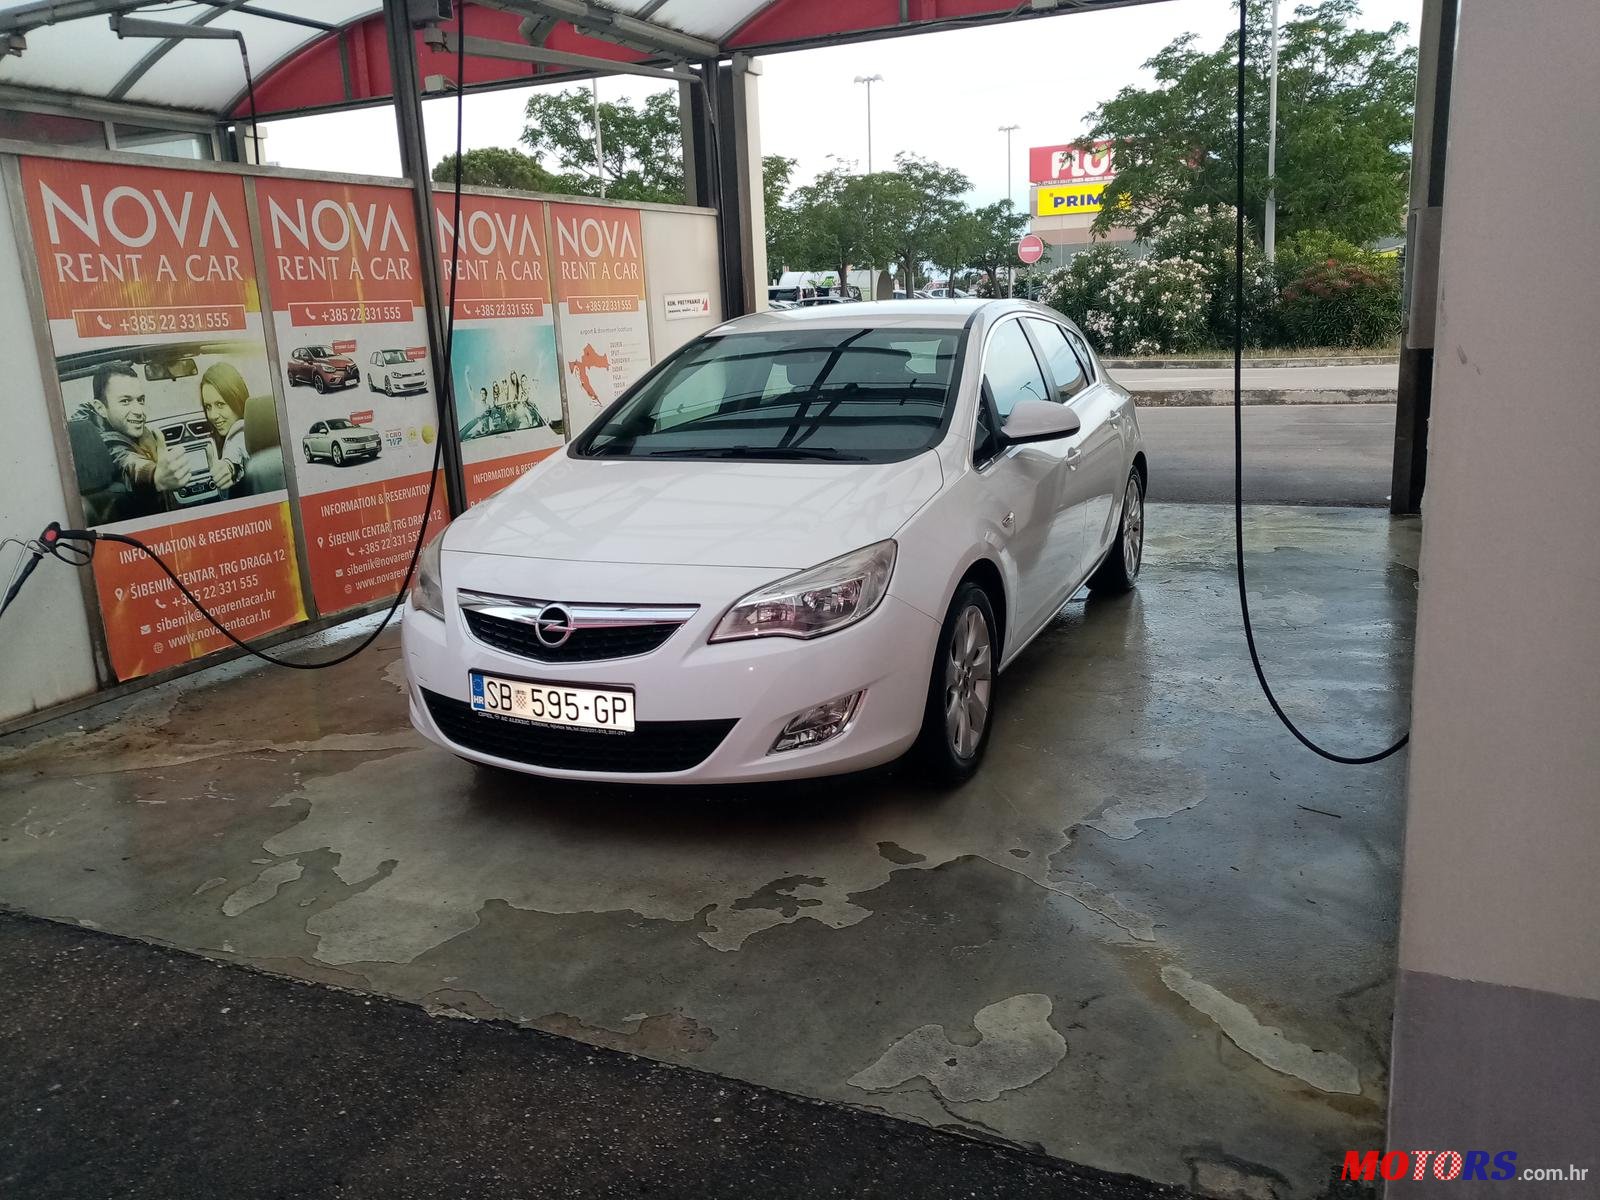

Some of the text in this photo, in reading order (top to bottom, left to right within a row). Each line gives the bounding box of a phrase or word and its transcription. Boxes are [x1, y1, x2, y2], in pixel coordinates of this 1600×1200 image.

[39, 179, 239, 249] NOVA
[1053, 194, 1102, 208] PRIM
[268, 196, 410, 252] NOVA
[436, 207, 541, 257] NOVA
[556, 216, 637, 258] NOVA
[54, 252, 244, 283] RENT A CAR
[277, 255, 413, 281] RENT A CAR
[444, 258, 544, 282] RENT A CAR
[562, 261, 639, 280] RENT A CAR
[321, 306, 401, 322] +385 22 331 555
[475, 303, 535, 317] +385 22 331 555
[585, 301, 600, 312] +385
[600, 301, 609, 311] 22
[621, 300, 632, 310] 555
[119, 312, 230, 332] +385 22 331 555
[473, 467, 515, 485] INFORMATION
[321, 483, 431, 518] INFORMATION & RESERVATION
[199, 533, 208, 546] &
[209, 518, 273, 545] RESERVATION
[328, 527, 361, 548] ŠIBENIK
[361, 522, 392, 540] CENTAR,
[392, 518, 407, 531] TRG
[433, 509, 442, 523] 12
[358, 539, 380, 556] +385
[381, 537, 391, 551] 22
[392, 533, 406, 549] 331
[130, 576, 175, 600] ŠIBENIK
[219, 561, 239, 577] TRG
[240, 552, 273, 571] DRAGA
[273, 548, 286, 562] 12
[203, 585, 217, 600] 22
[218, 579, 238, 596] 331
[240, 574, 259, 591] 555
[156, 588, 277, 633] sibenik@ovarentacar.hr
[168, 607, 272, 649] www.novaentacar.hr
[473, 696, 484, 705] HR
[486, 681, 627, 724] SB 595-GP
